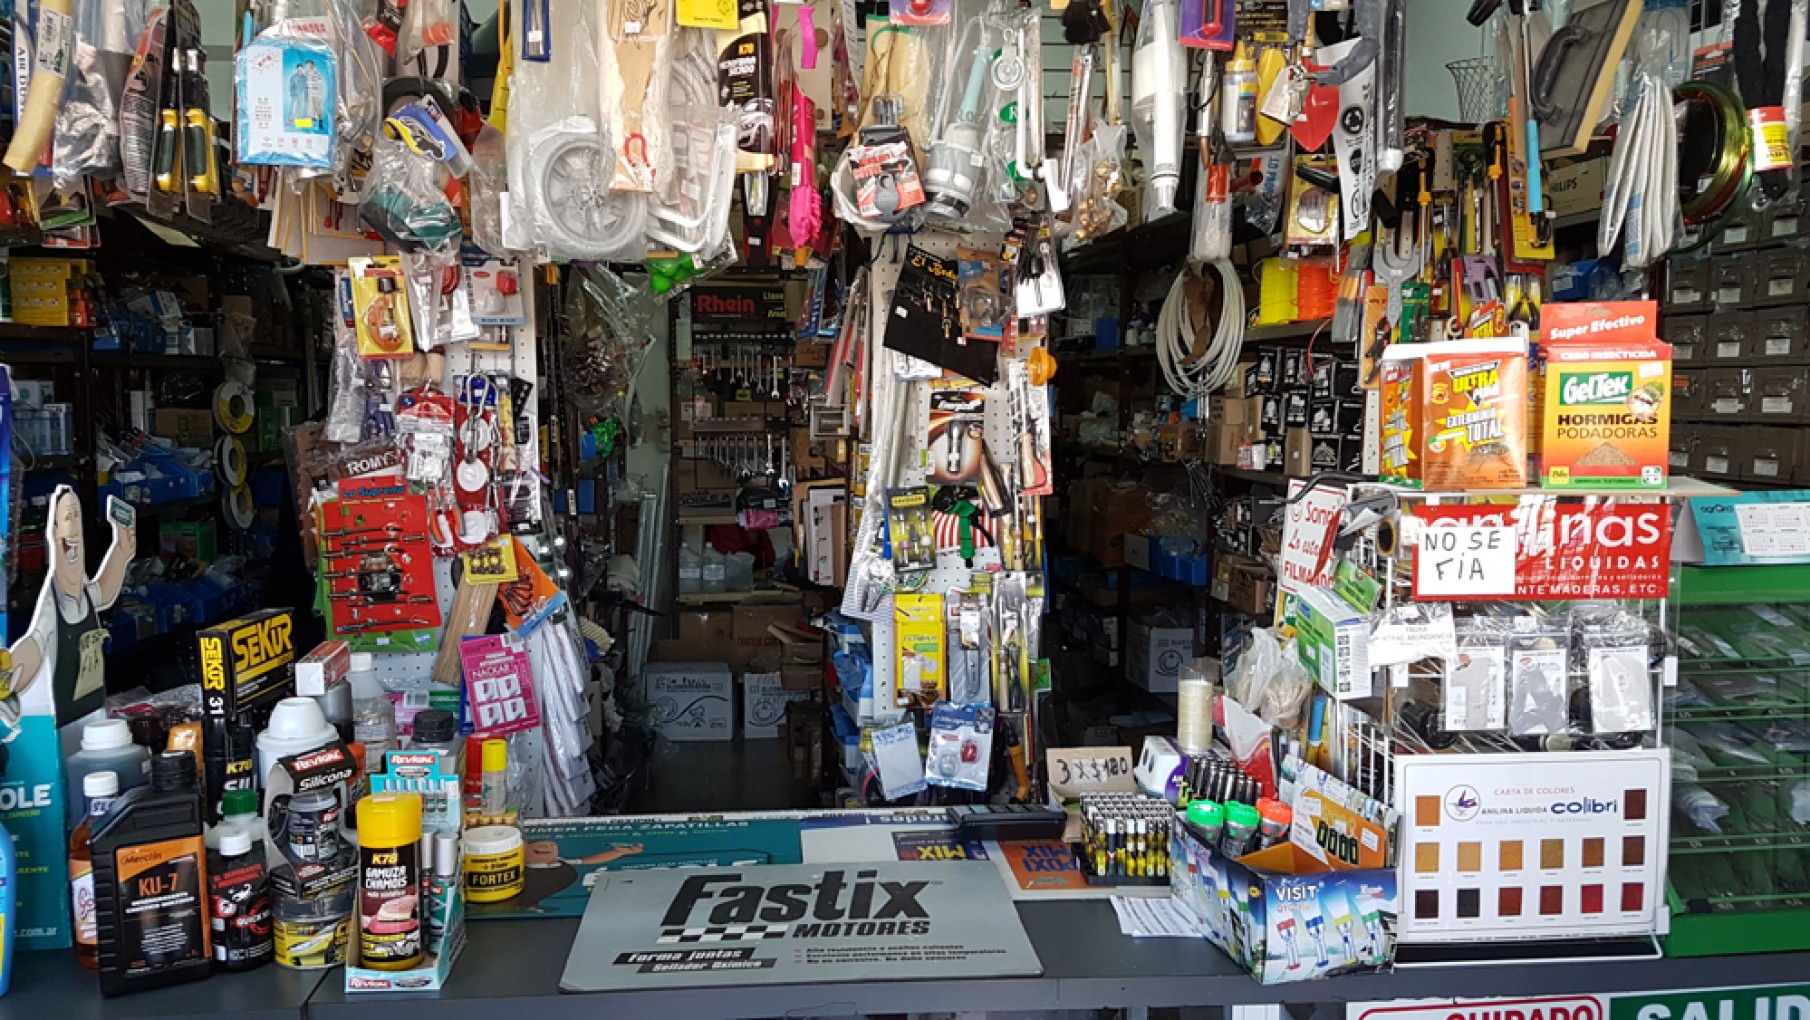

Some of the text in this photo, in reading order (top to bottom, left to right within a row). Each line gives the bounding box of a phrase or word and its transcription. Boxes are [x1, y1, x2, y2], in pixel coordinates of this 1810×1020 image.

[697, 294, 755, 313] Rhein
[1550, 314, 1646, 341] Super Efectivo
[1557, 413, 1659, 426] HORMIGAS
[1557, 427, 1658, 440] PODADORAS
[1424, 530, 1501, 551] NO SE
[1545, 555, 1660, 570] LIQUIDAS
[1517, 584, 1546, 595] NTE
[232, 612, 293, 672] SEKUR
[208, 696, 224, 715] 31
[300, 768, 353, 791] Silicona
[1056, 758, 1072, 785] 3
[1494, 786, 1576, 796] CARTA DE COLORES
[1481, 806, 1514, 815] ANILINA
[1550, 796, 1618, 815] colibri
[916, 845, 966, 860] MIX
[138, 872, 179, 896] KU-7
[472, 869, 516, 885] FORTEX
[660, 869, 931, 926] Fastix
[1275, 885, 1318, 902] VISIT
[792, 919, 931, 938] MOTORES
